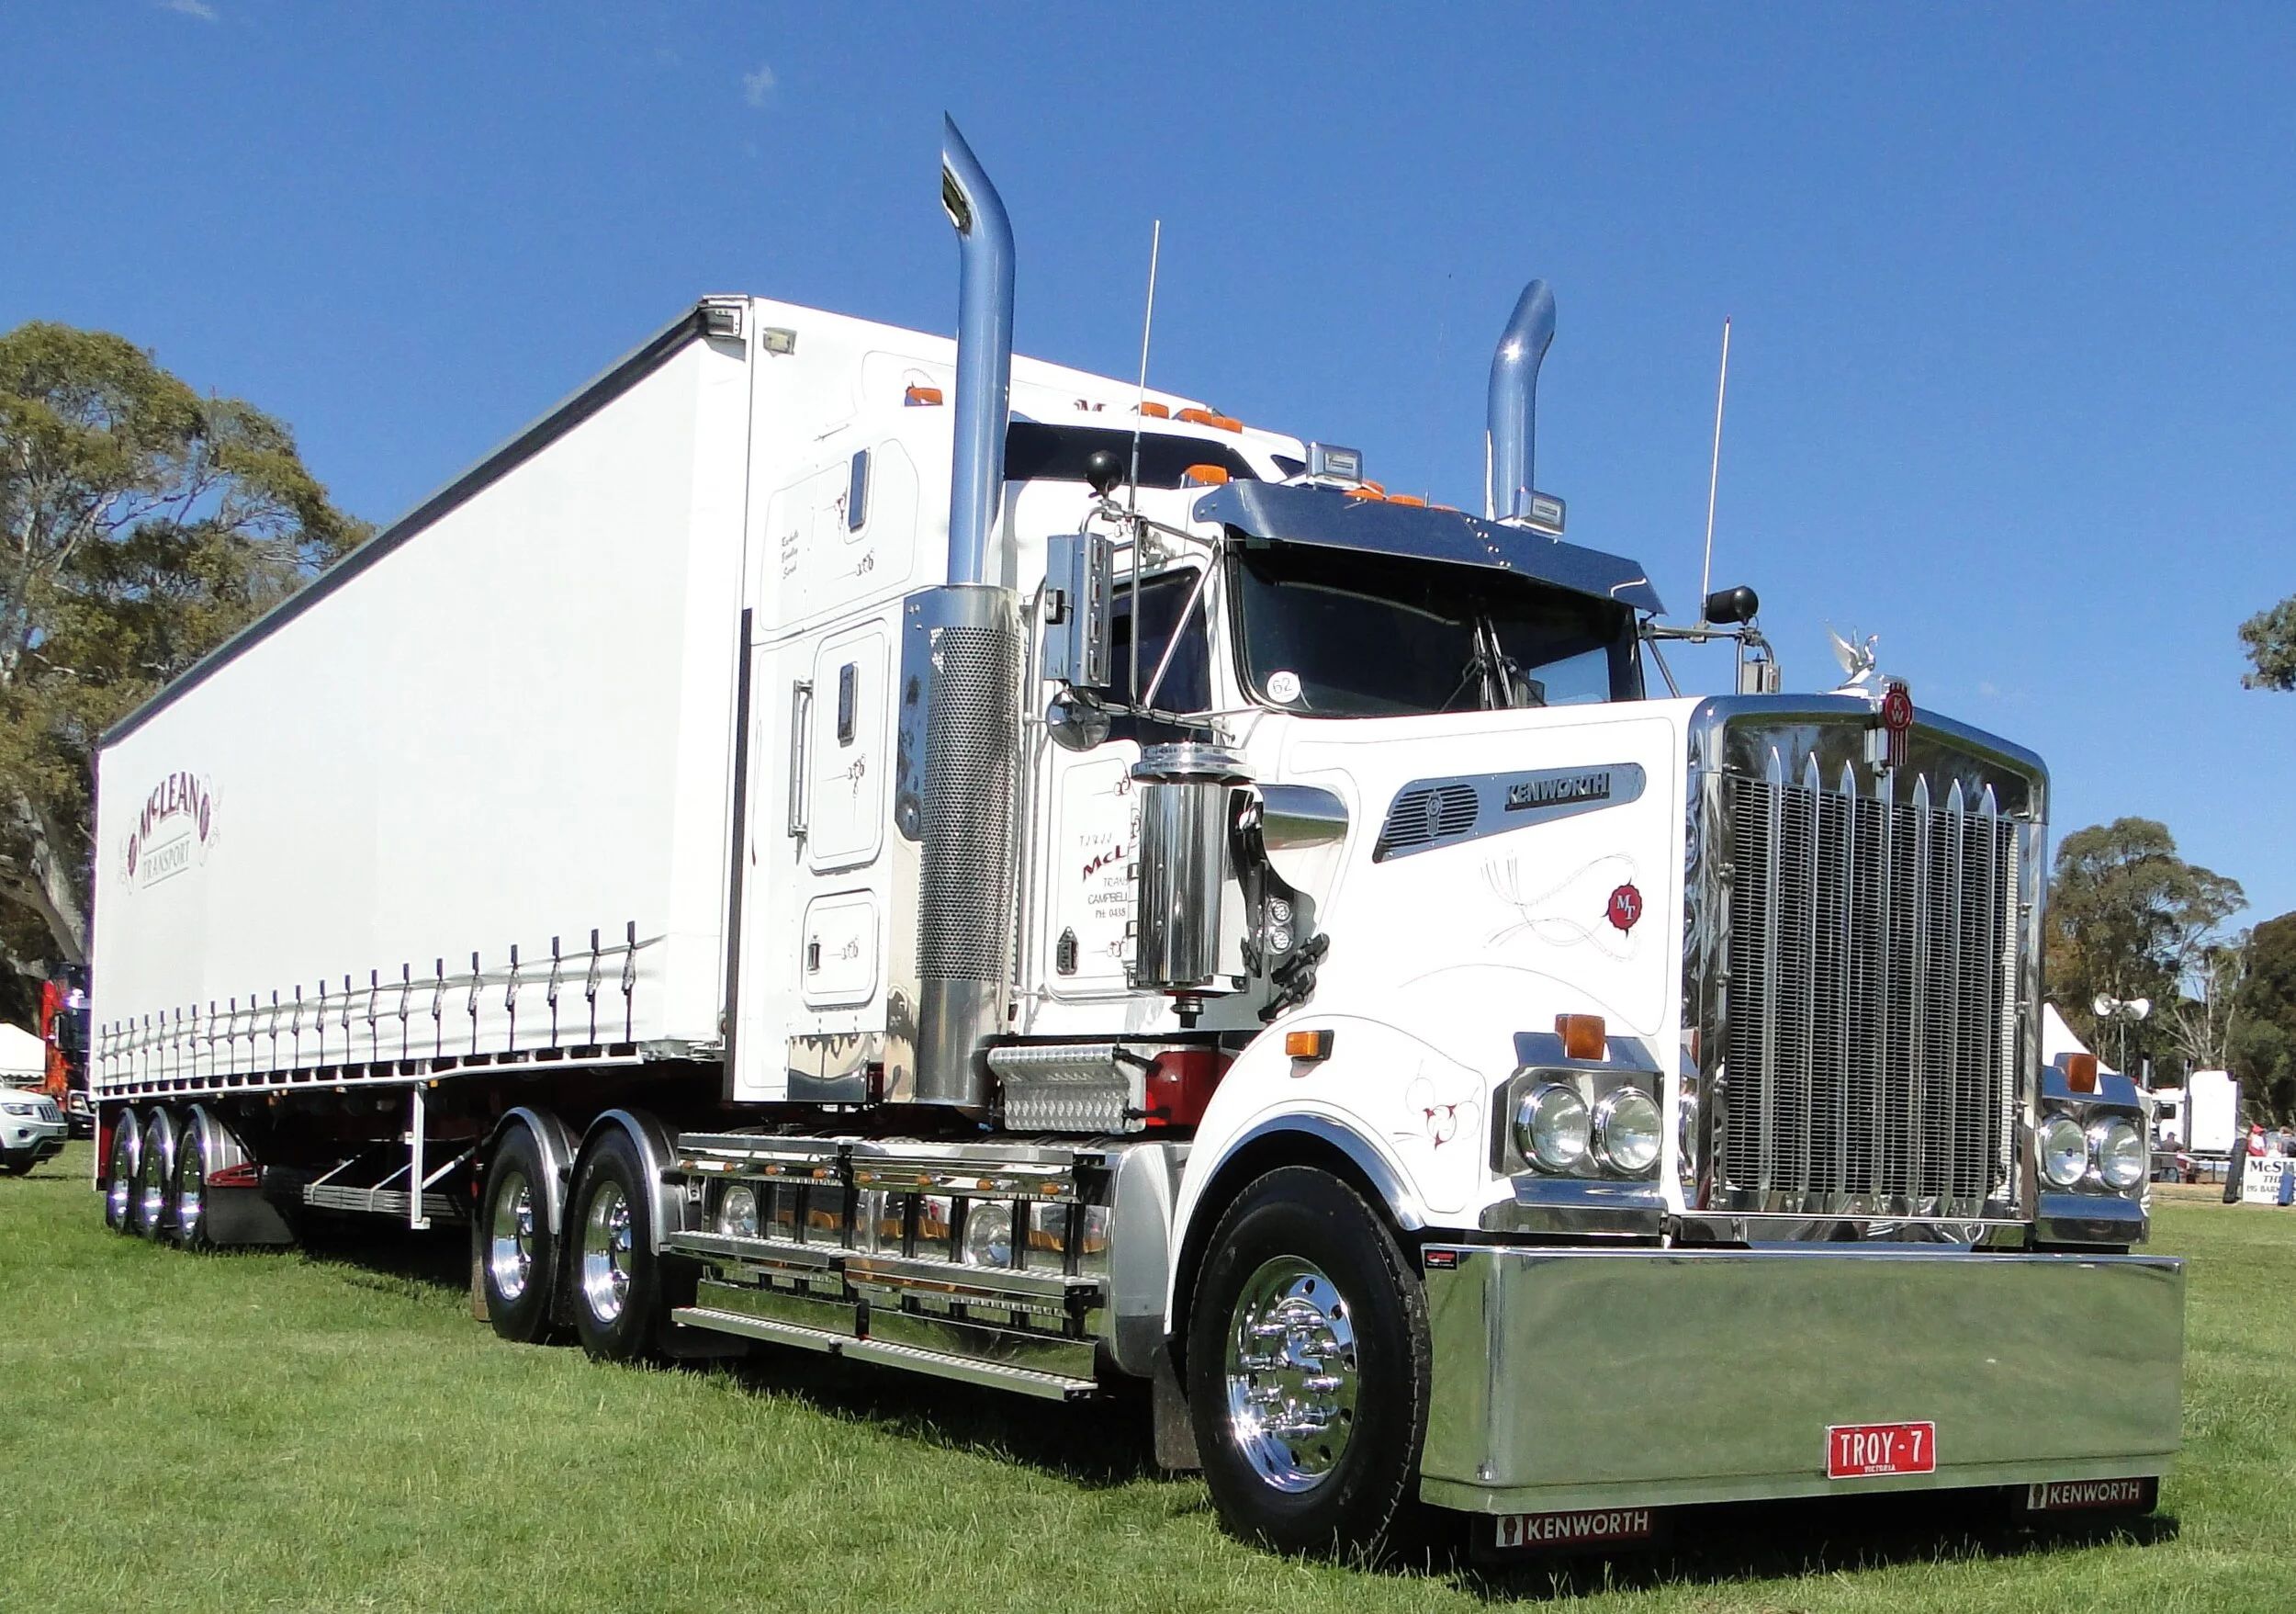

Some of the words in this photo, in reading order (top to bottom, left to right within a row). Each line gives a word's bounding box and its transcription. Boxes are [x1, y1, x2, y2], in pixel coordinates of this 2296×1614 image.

[1273, 677, 1293, 694] 62
[1507, 773, 1610, 805] KENWORTH
[143, 841, 190, 882] TRANSPORT
[1863, 1464, 1896, 1473] VICTORIA
[2049, 1482, 2140, 1505] KENWORTH
[1527, 1511, 1649, 1541] KENWORTH
